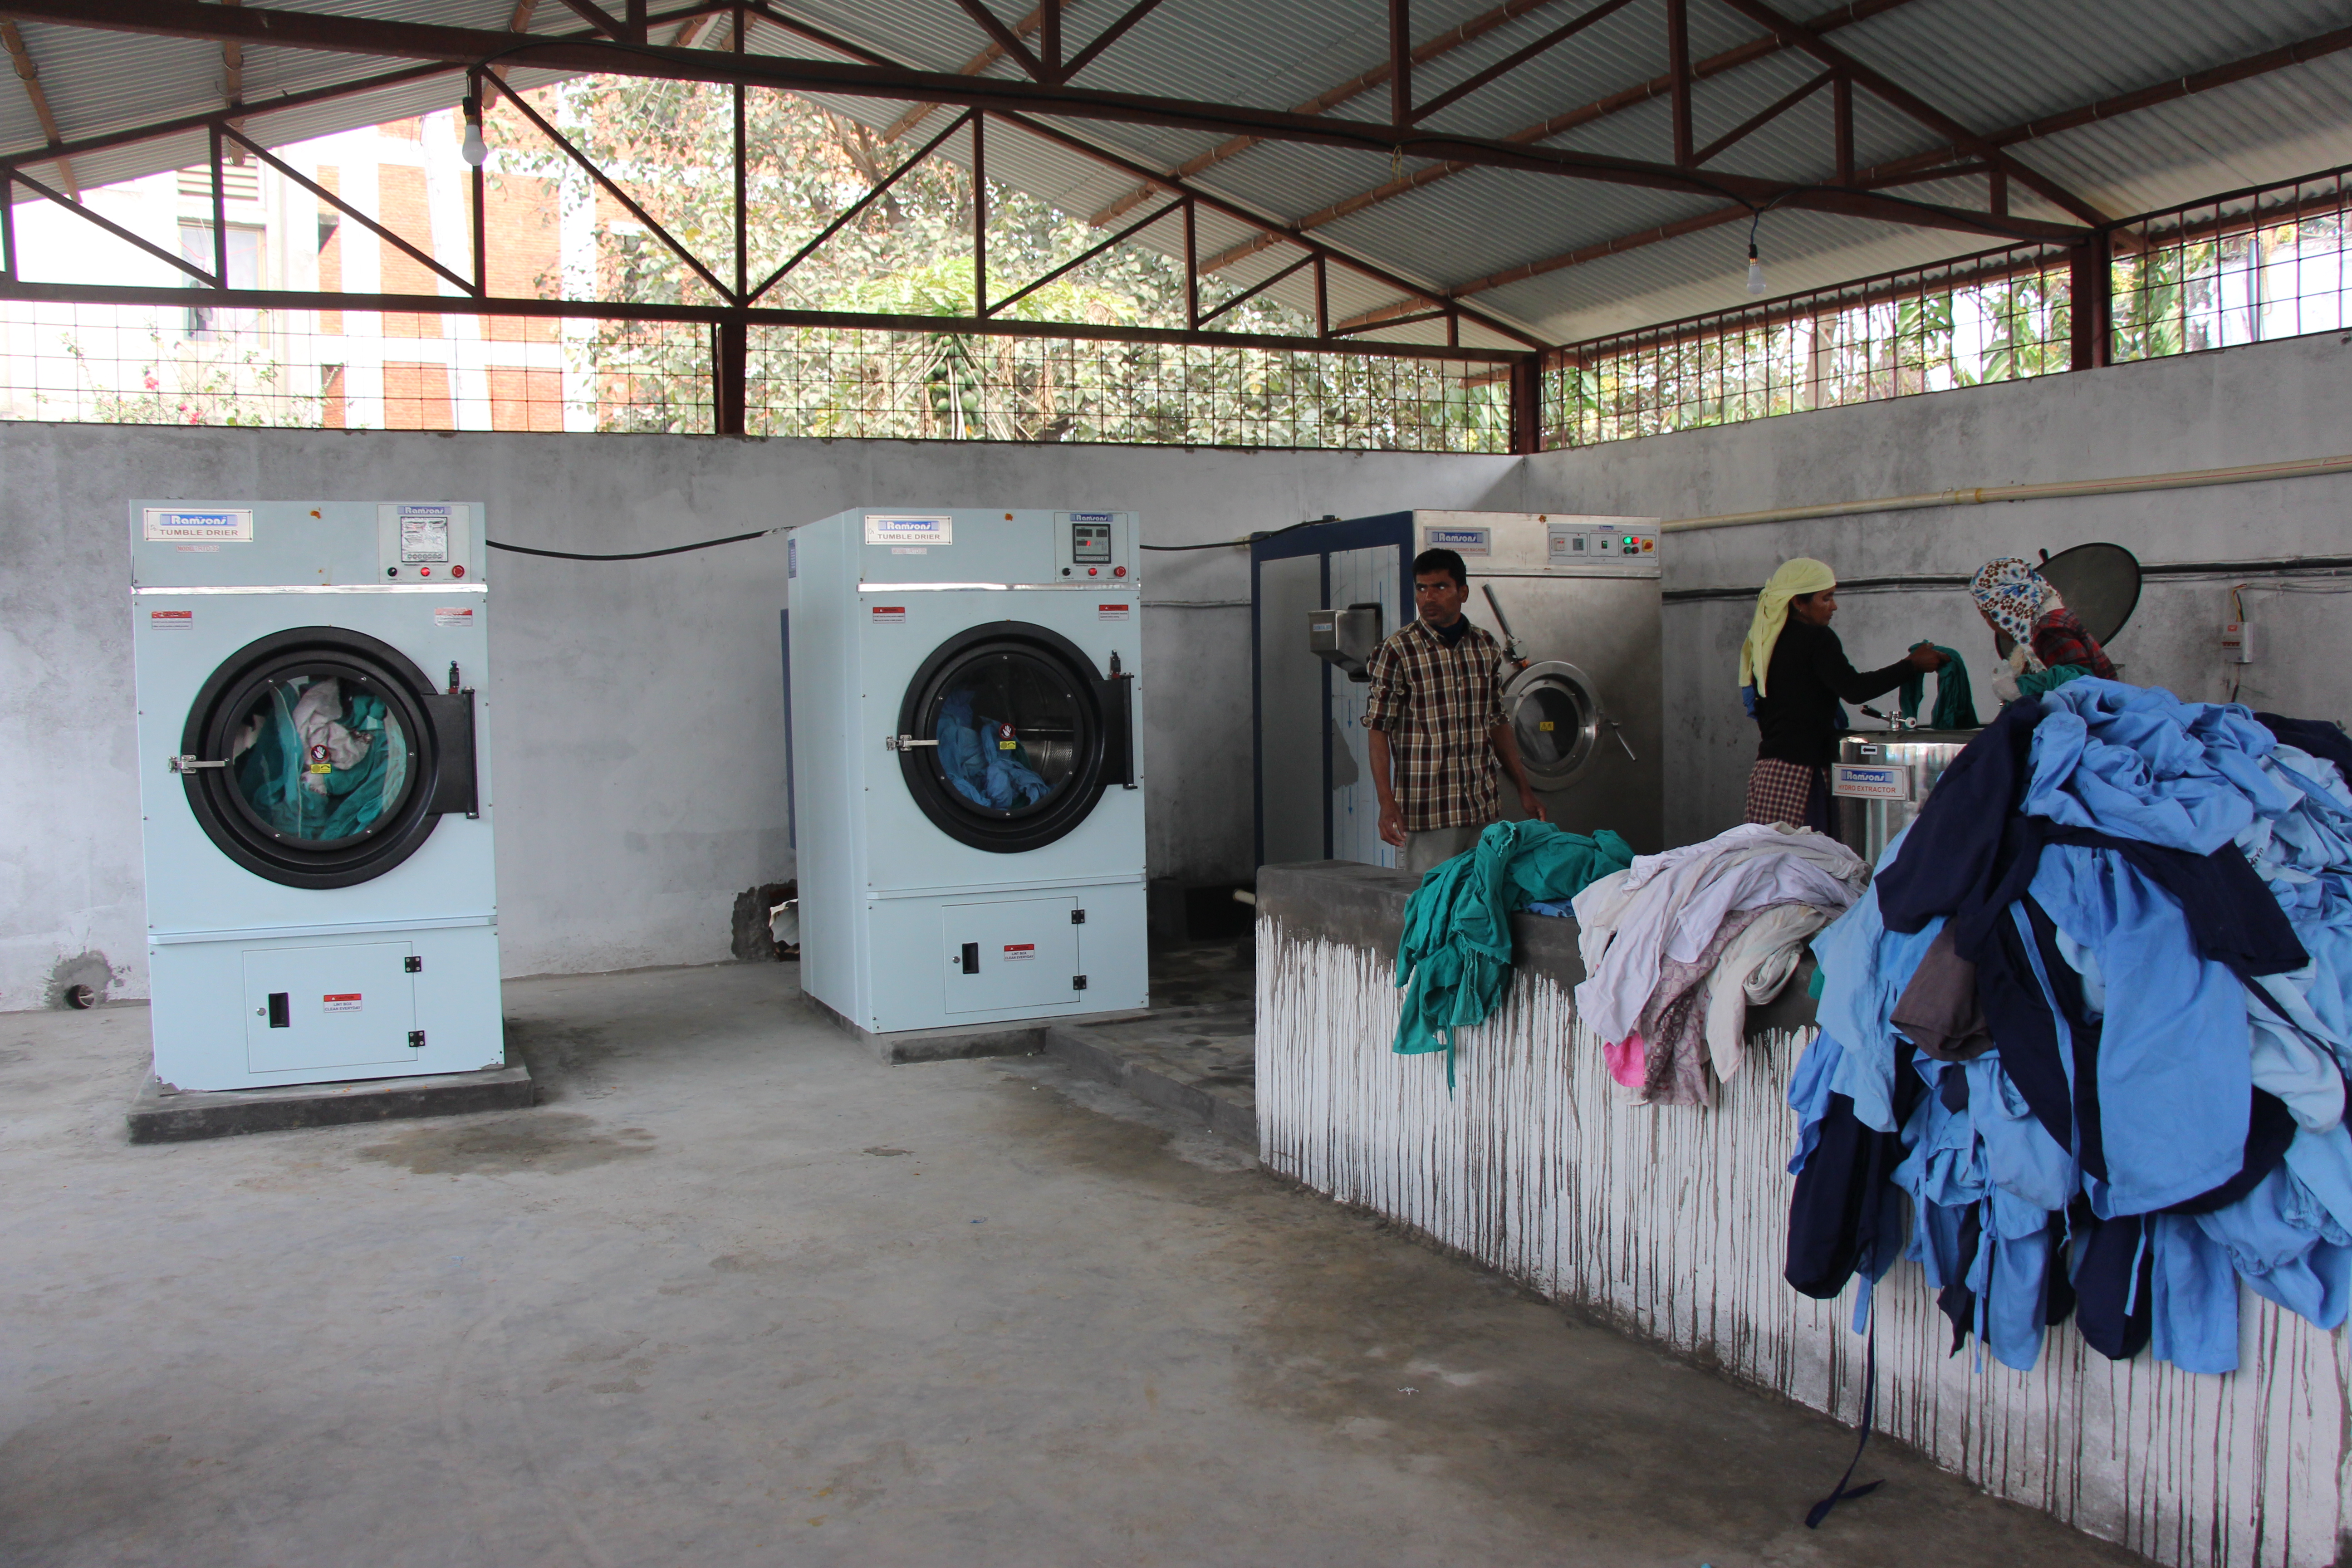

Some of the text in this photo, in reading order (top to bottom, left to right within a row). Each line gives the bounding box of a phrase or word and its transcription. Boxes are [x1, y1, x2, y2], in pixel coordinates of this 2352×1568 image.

[171, 515, 227, 524] Ramsons
[1438, 533, 1476, 542] Ramsons
[1847, 771, 1885, 781] Ramsons
